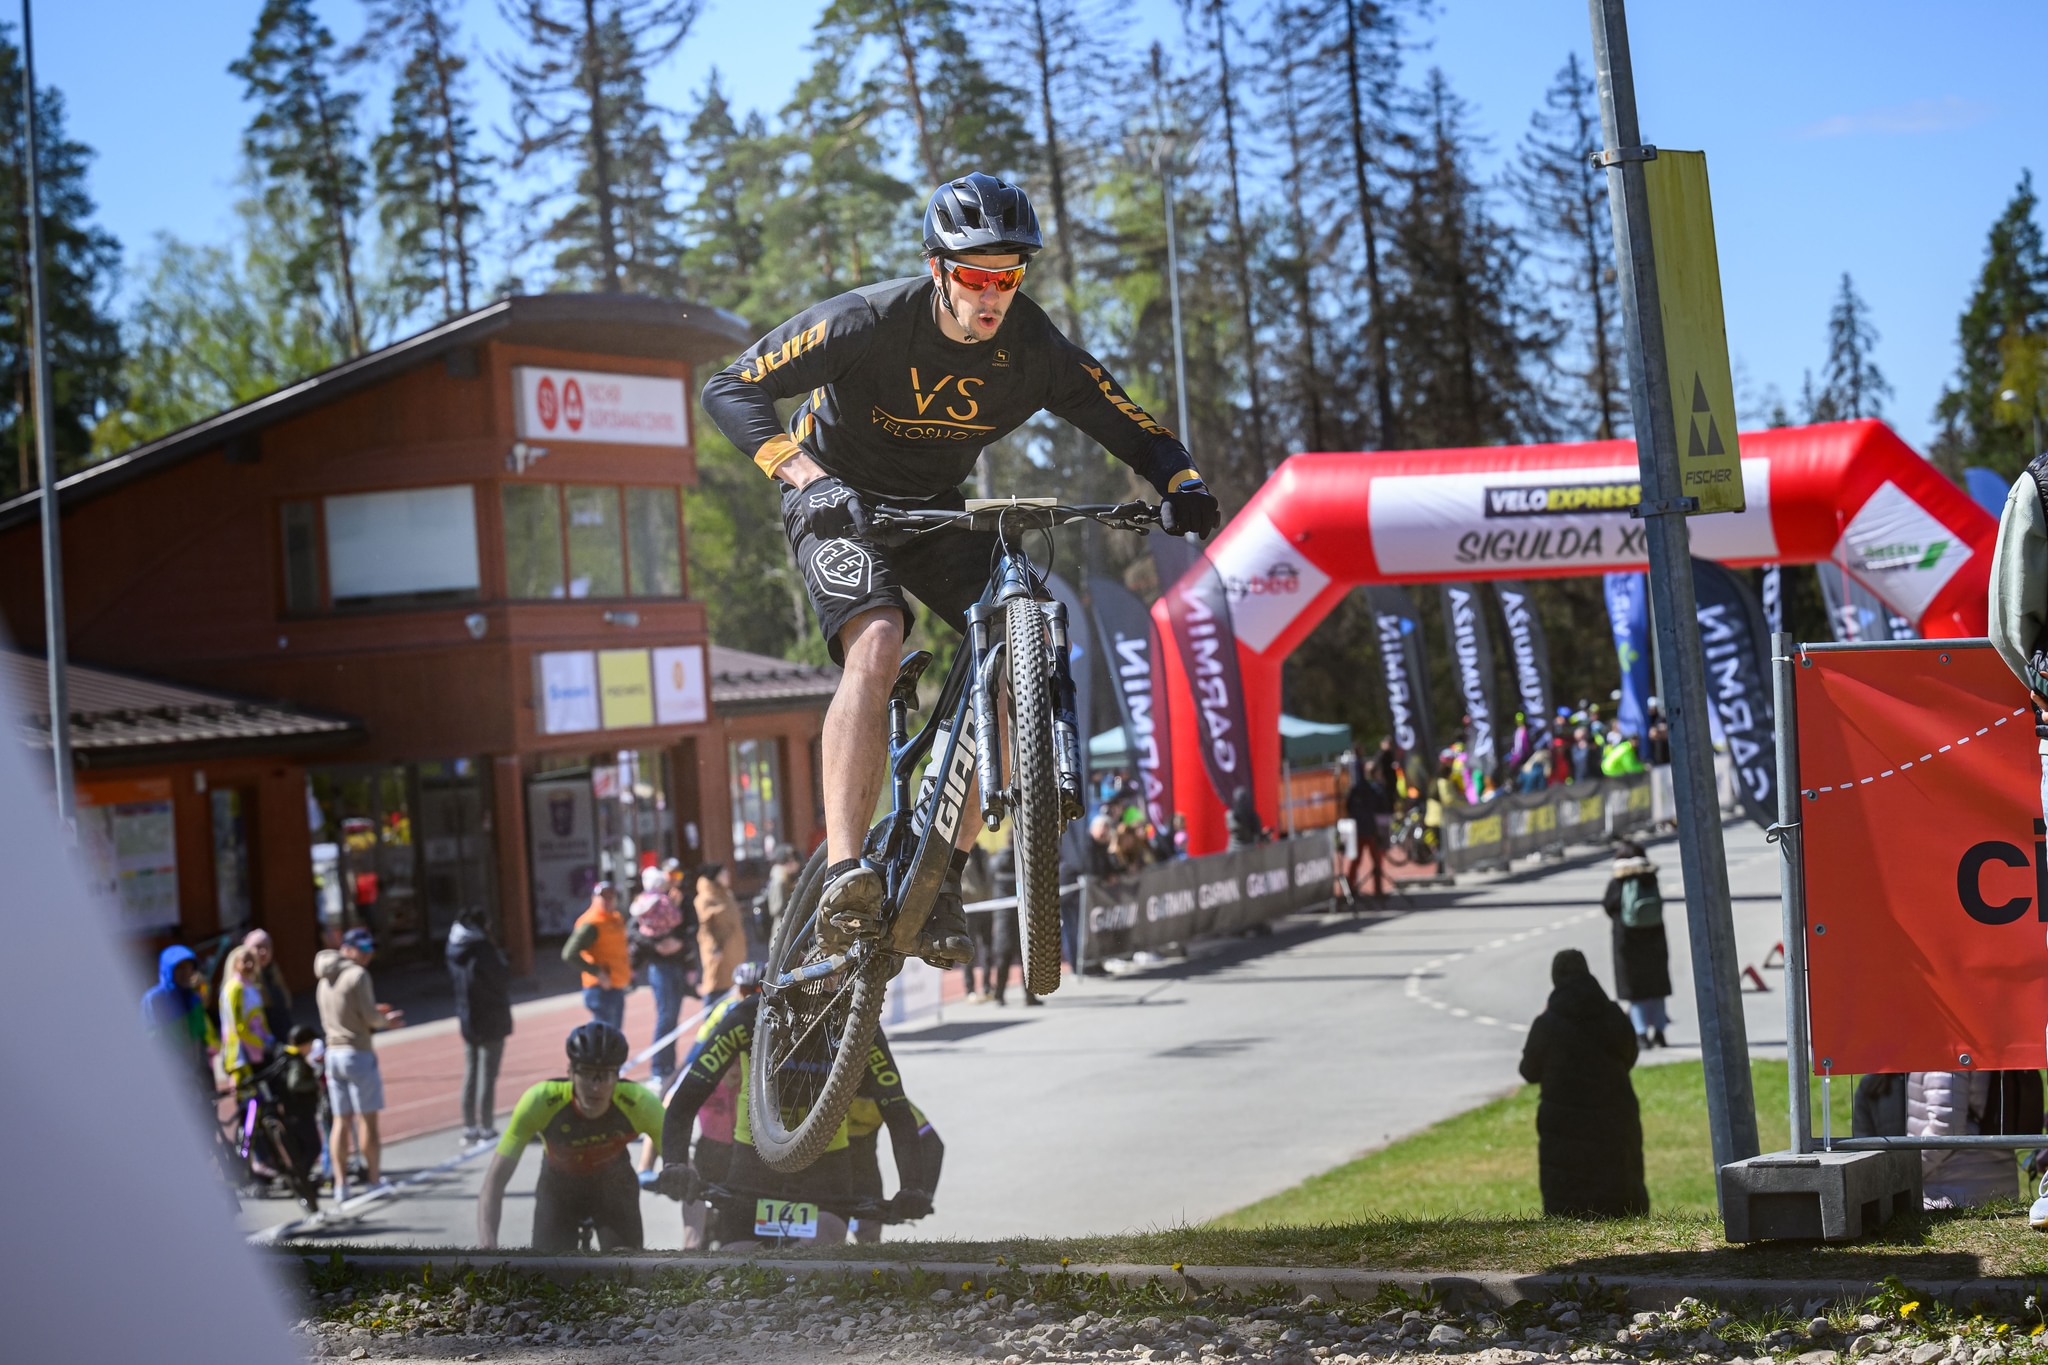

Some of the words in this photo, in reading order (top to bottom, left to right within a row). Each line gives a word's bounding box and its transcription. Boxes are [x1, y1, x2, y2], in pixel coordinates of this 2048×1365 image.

[910, 367, 985, 421] VS
[1684, 468, 1732, 486] FISCHER
[1489, 484, 1643, 514] VELOEXPRESS
[1454, 525, 1604, 564] SIGULDA
[934, 690, 978, 844] GIAN
[1957, 817, 2048, 926] ci
[870, 1044, 900, 1087] ELO
[765, 1203, 809, 1226] 141
